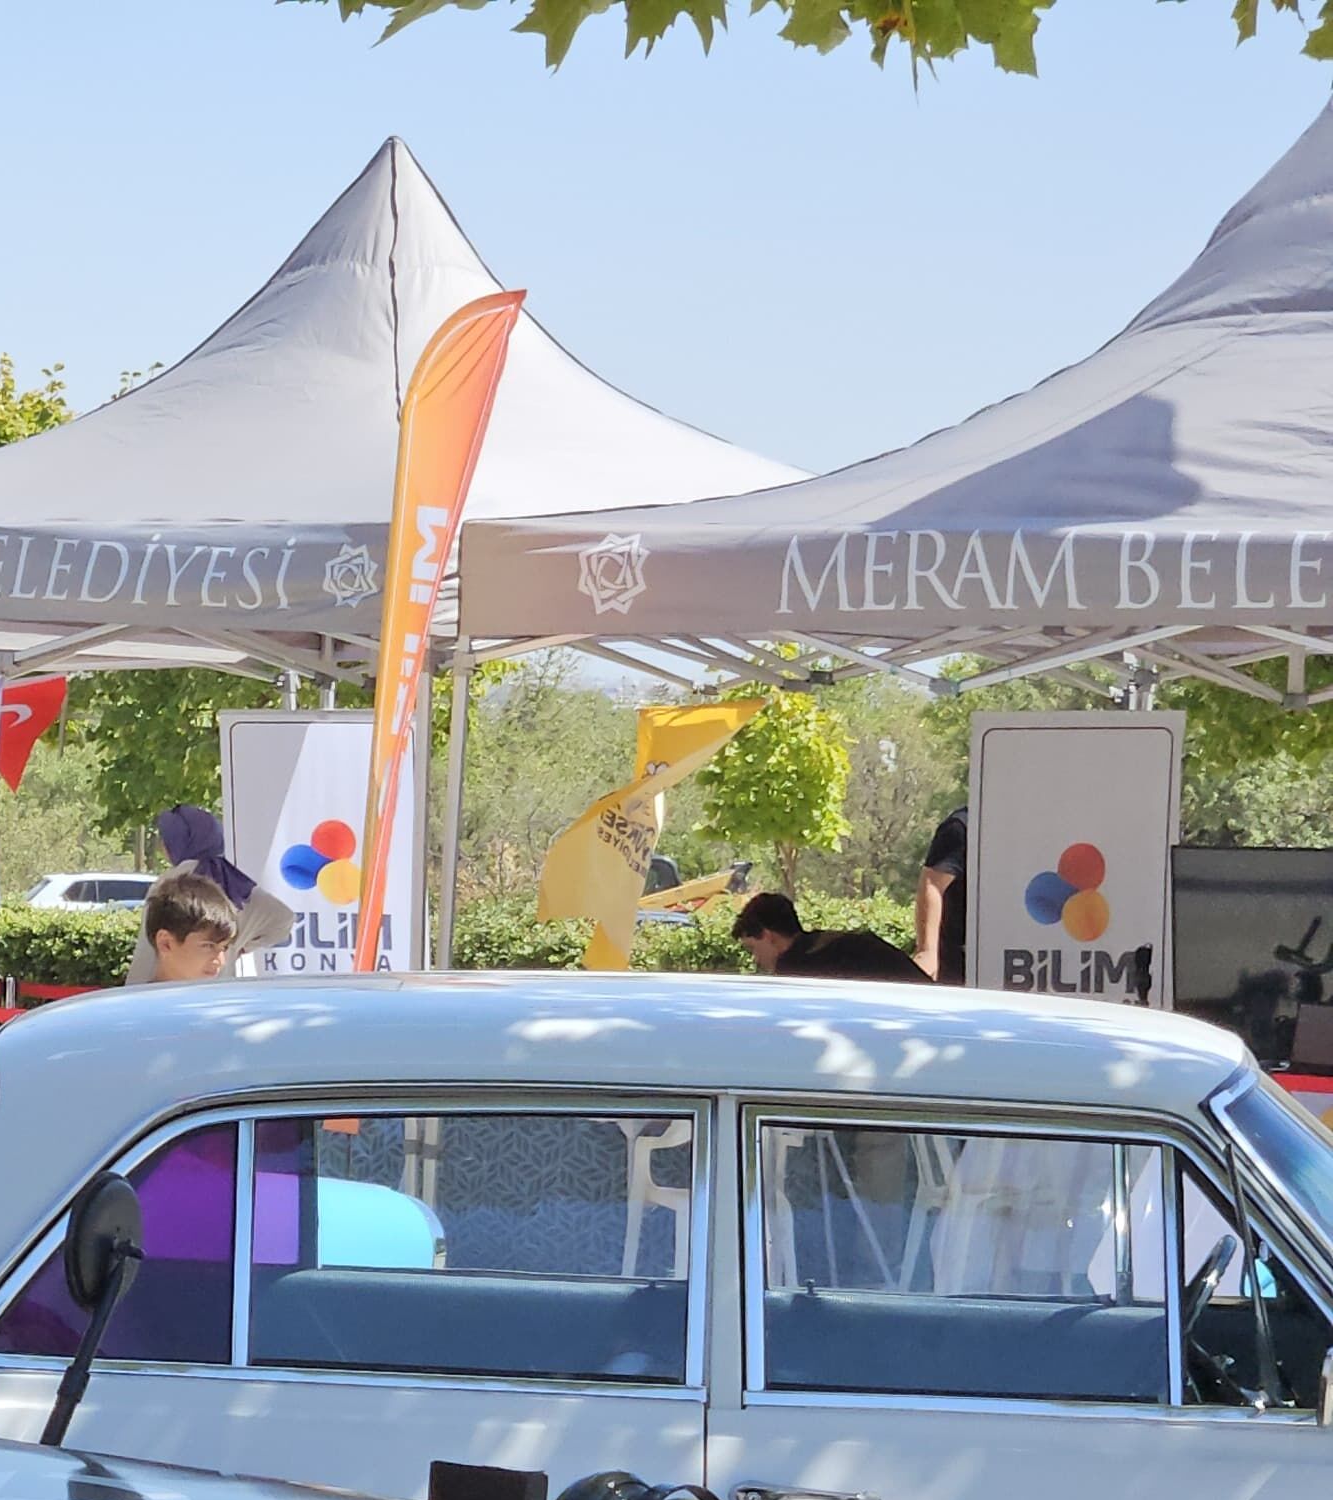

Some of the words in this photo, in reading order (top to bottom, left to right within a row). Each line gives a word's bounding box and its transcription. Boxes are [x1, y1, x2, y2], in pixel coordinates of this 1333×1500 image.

[775, 528, 1088, 614] MERAM
[1114, 529, 1333, 610] BELE
[264, 952, 392, 972] KONA
